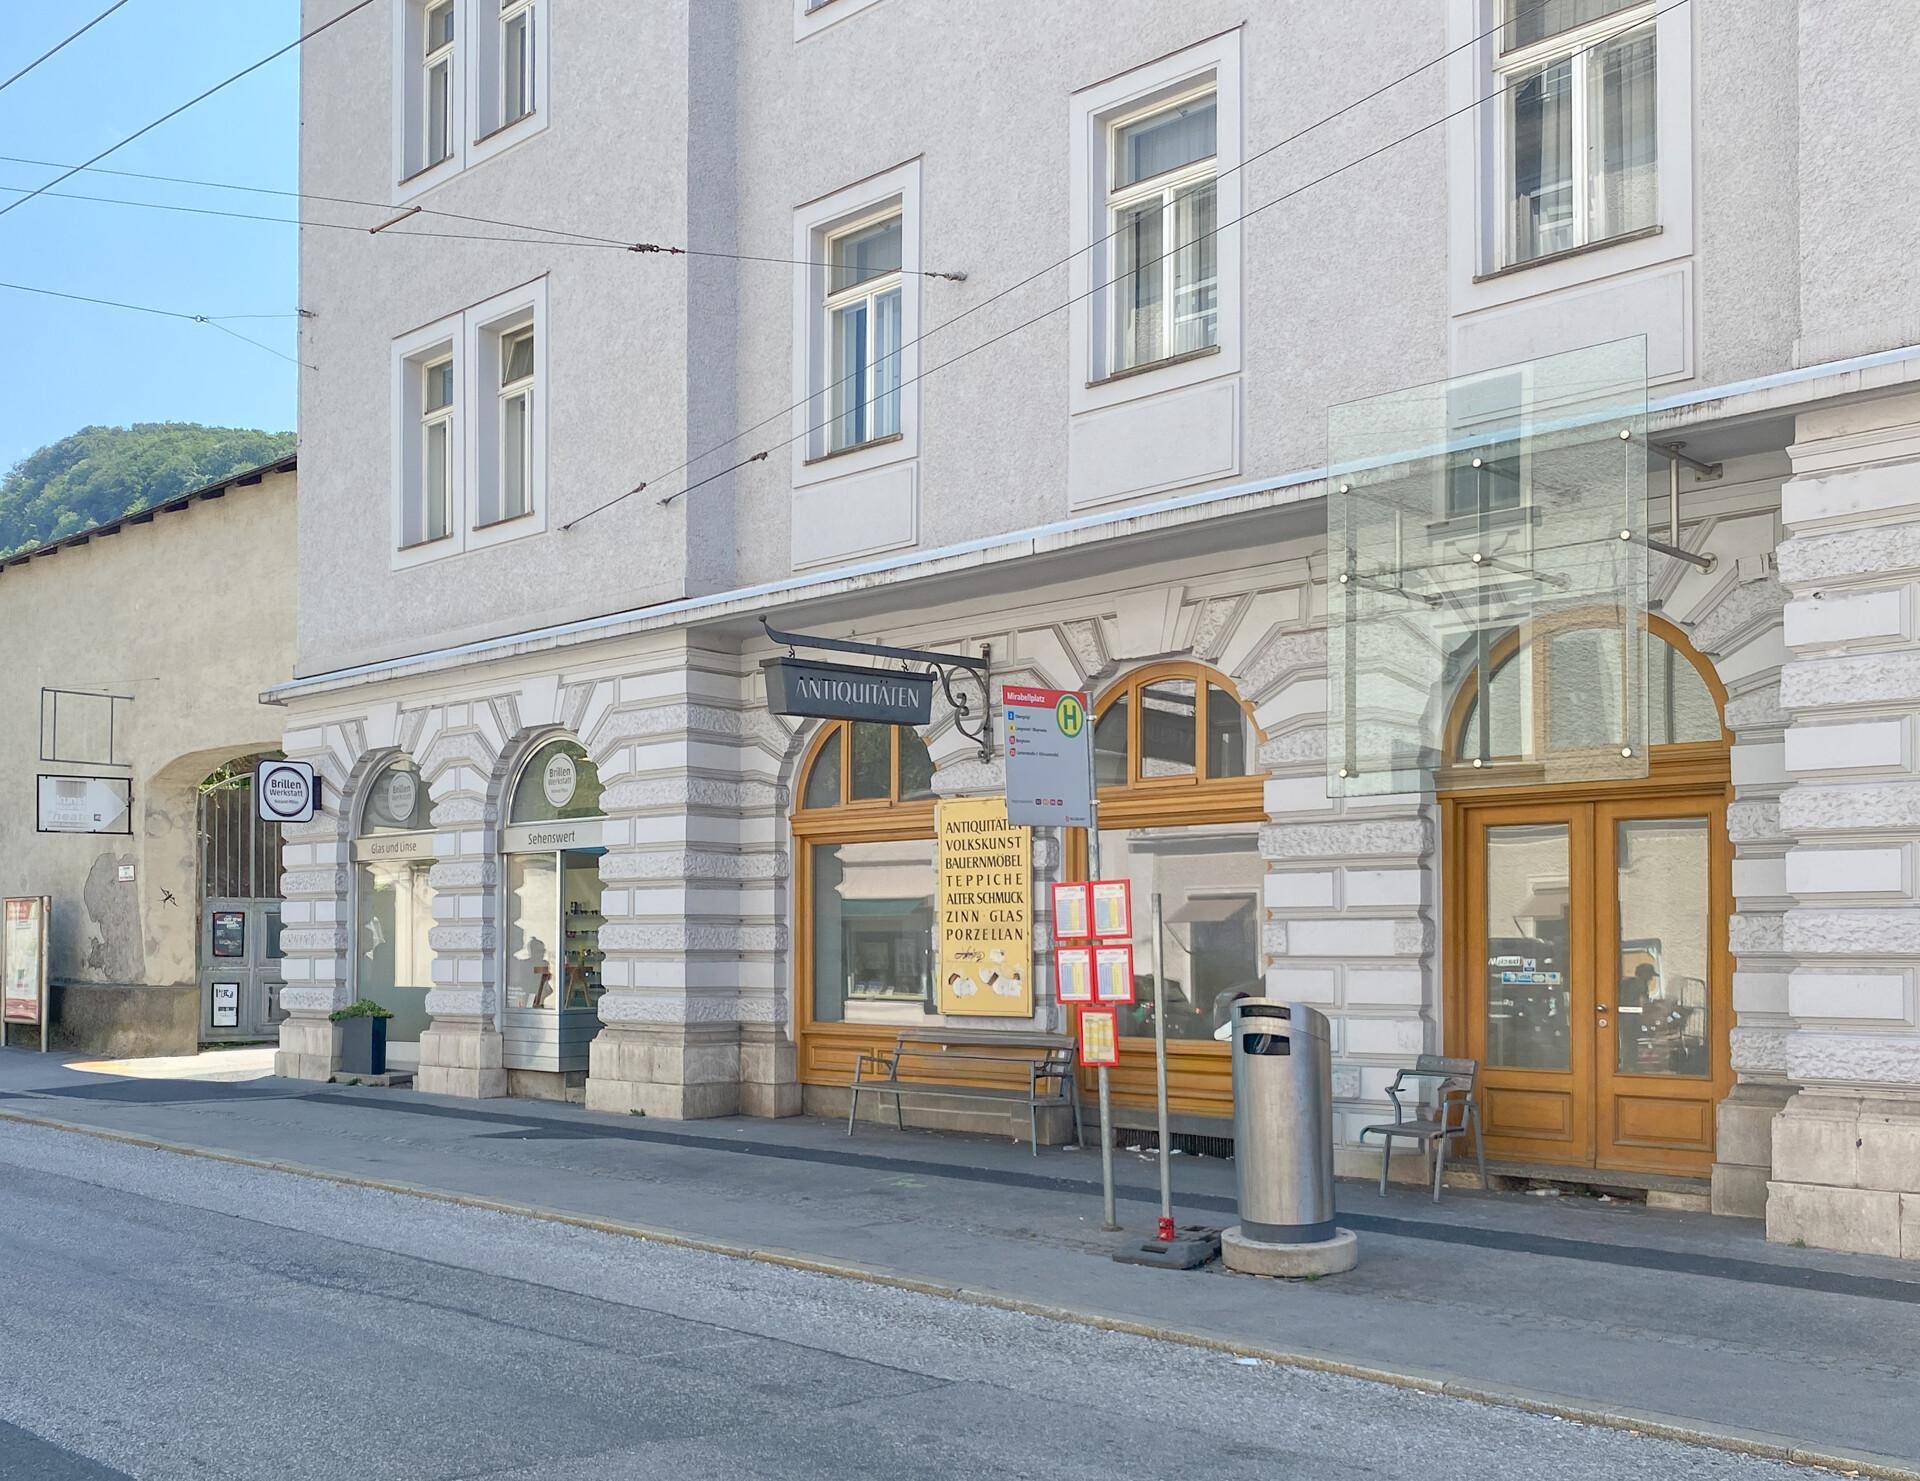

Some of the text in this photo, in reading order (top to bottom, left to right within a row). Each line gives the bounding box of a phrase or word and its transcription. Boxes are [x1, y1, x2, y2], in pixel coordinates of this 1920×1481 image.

[795, 678, 919, 708] ANTIQUITÄTEN
[1007, 692, 1045, 704] Mirabellplatz
[1063, 704, 1077, 730] H
[549, 767, 571, 778] Brillen
[271, 778, 301, 789] Brillen
[269, 789, 303, 797] Werkstatt
[528, 830, 575, 845] Sehenswert
[946, 836, 1022, 851] VOLKSKUNST
[371, 841, 417, 854] Glas und Linse
[945, 854, 1022, 869] BAUERNMÖBEL
[946, 873, 1023, 887] TEPPICHE
[946, 891, 1024, 905] ALTER SCHMUCK
[946, 909, 1023, 923] ZINN GLAS
[946, 928, 1023, 941] PORZELLAN
